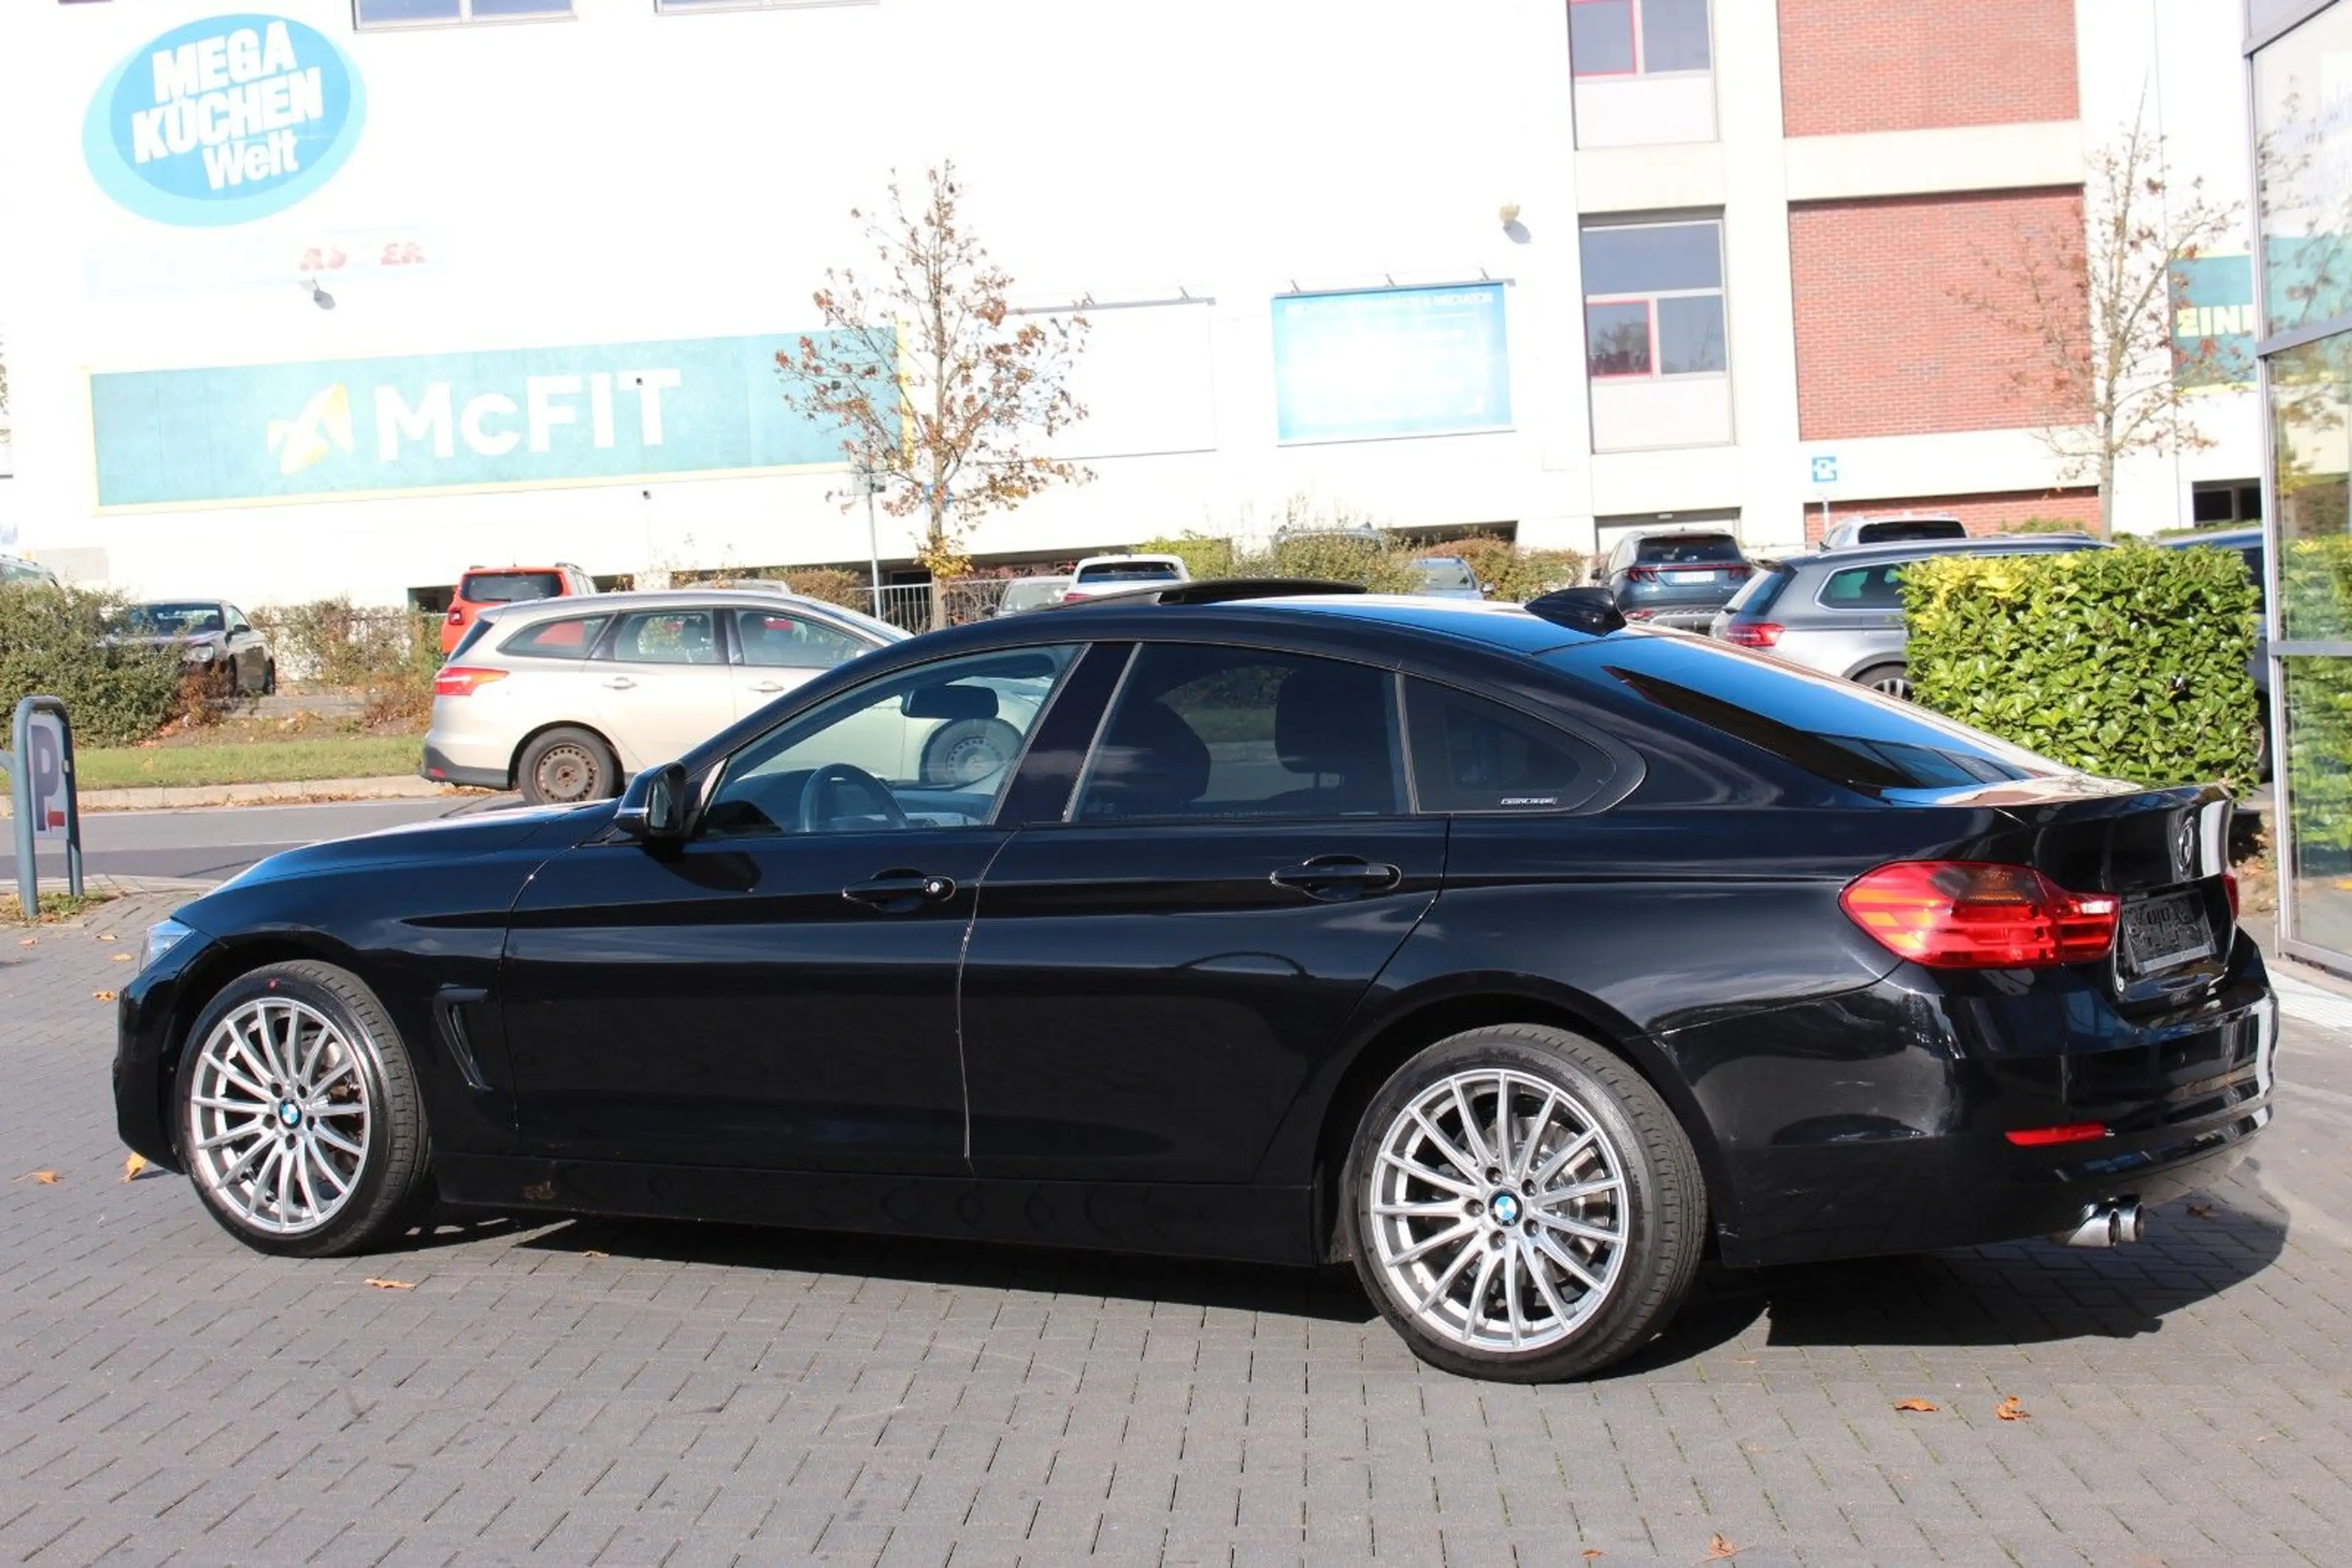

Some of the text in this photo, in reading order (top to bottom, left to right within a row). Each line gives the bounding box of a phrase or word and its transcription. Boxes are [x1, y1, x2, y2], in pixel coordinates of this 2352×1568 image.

[152, 20, 298, 104] MEGA
[202, 129, 300, 191] Welt
[374, 368, 682, 461] McFIT
[31, 724, 58, 831] P
